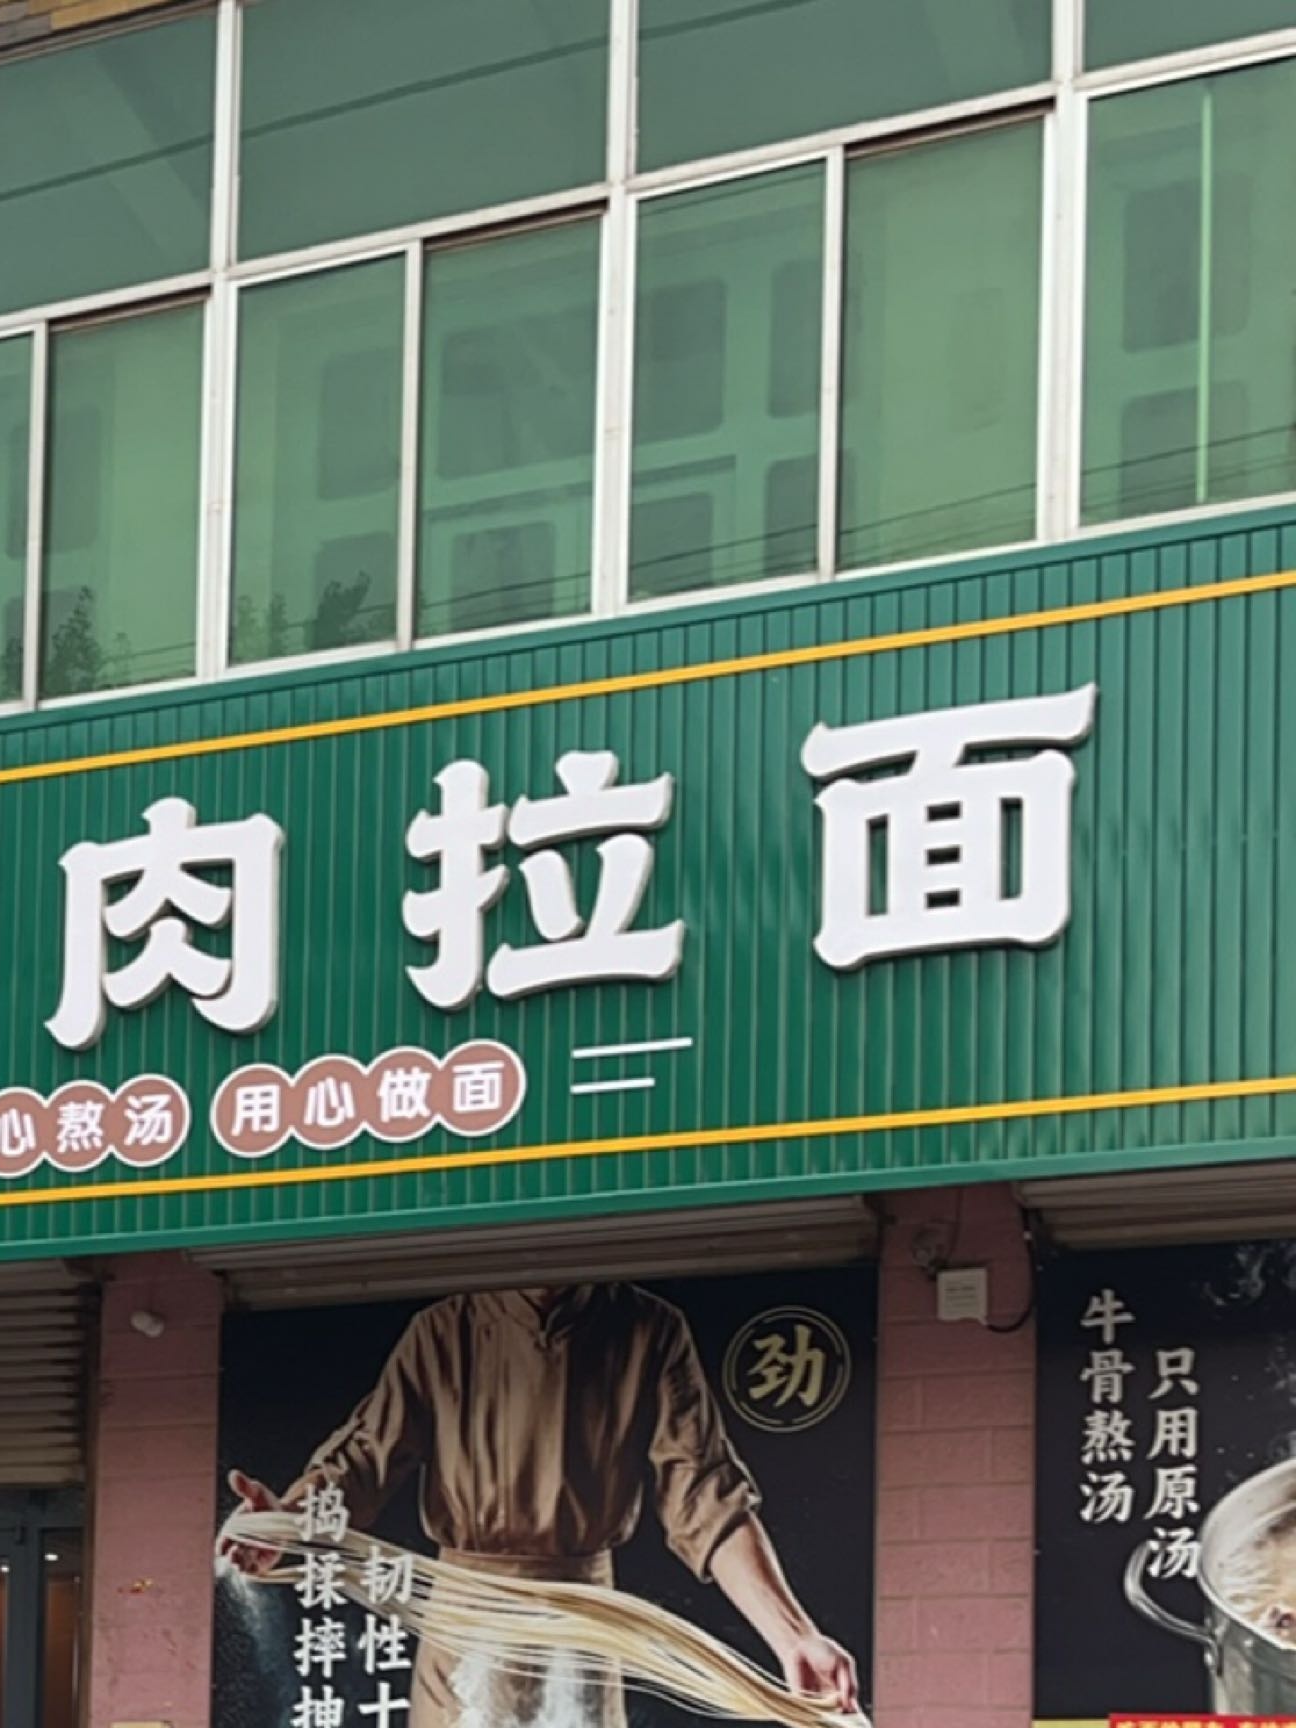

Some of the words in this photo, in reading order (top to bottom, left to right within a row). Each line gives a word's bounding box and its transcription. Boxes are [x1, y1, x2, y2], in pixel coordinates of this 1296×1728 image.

[232, 1059, 504, 1136] 用心做面
[747, 1324, 825, 1408] 劲
[1079, 1288, 1135, 1523] 牛骨熬汤
[1144, 1347, 1201, 1578] 只用原汤
